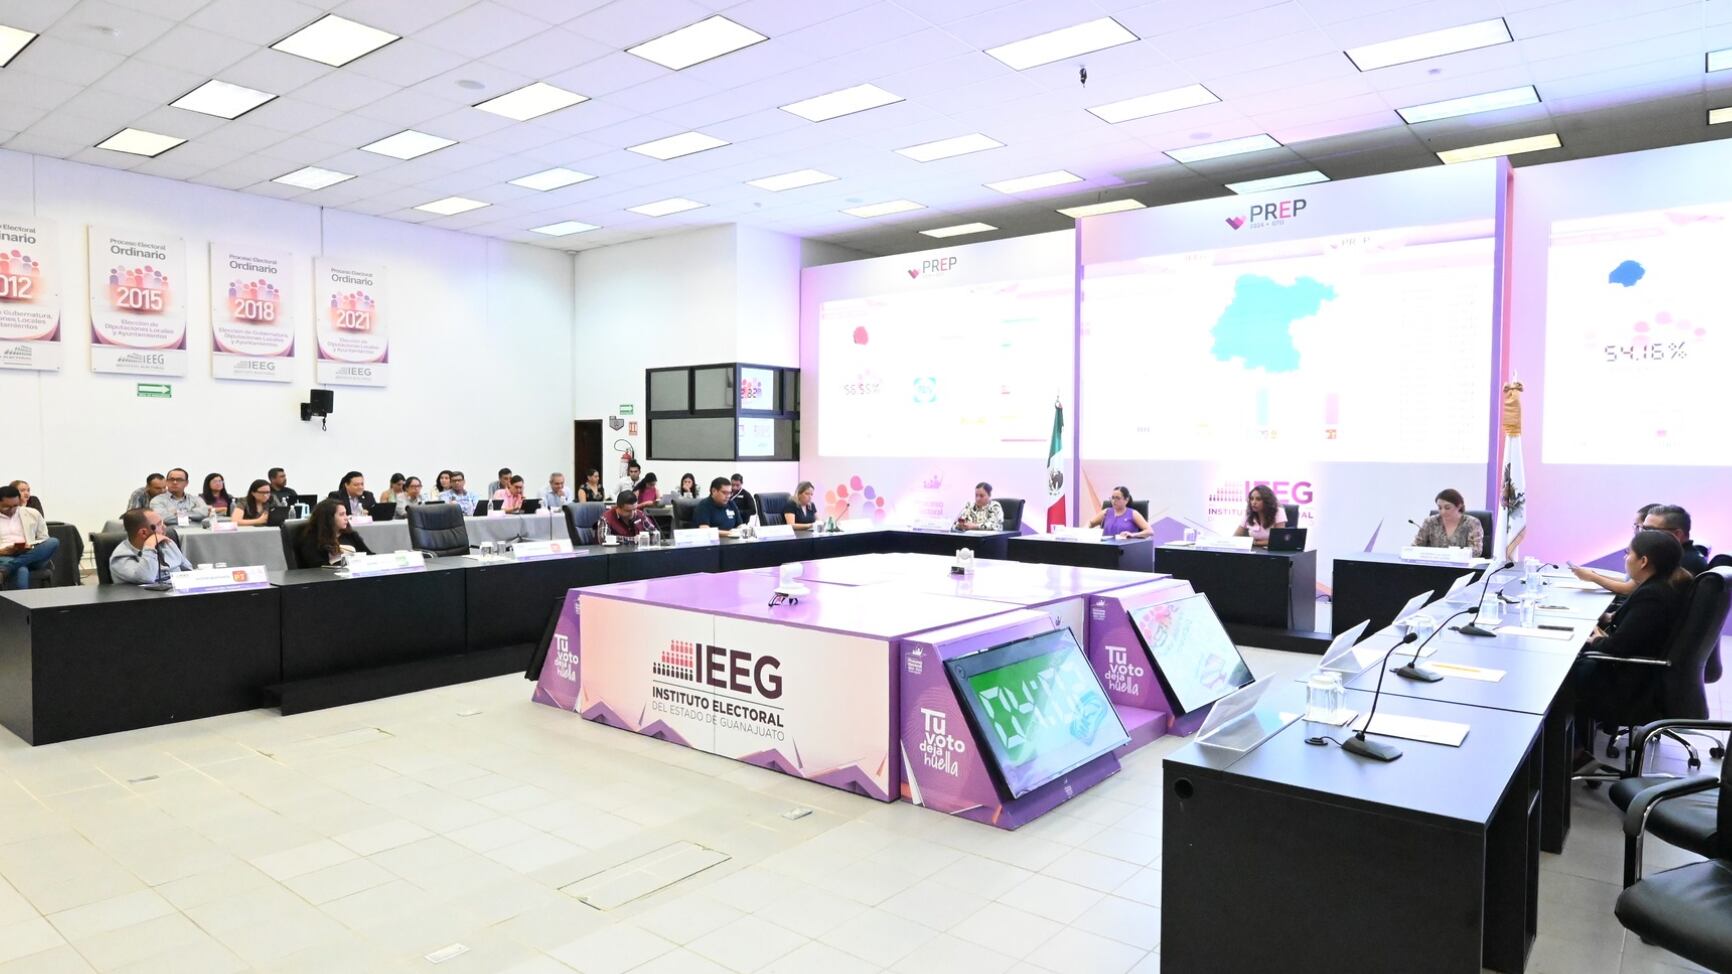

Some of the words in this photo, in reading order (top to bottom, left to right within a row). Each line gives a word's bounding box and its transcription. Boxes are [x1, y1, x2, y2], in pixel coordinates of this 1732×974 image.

[1250, 199, 1307, 223] PREP
[110, 245, 166, 260] Ordinario
[229, 260, 278, 274] Ordinario
[922, 256, 957, 273] PREP
[331, 274, 373, 286] Ordinario
[117, 286, 162, 310] 2015
[234, 299, 275, 320] 2018
[336, 309, 370, 329] 2021
[143, 354, 164, 365] IEEG
[248, 361, 276, 370] IEEG
[348, 368, 372, 376] IEEG
[554, 633, 569, 652] Tu
[557, 651, 579, 664] voto
[1105, 645, 1127, 665] Tu
[696, 643, 783, 700] IEEG
[1104, 670, 1125, 683] deja
[1109, 664, 1144, 677] voto
[1109, 676, 1139, 696] huella
[652, 686, 709, 710] INSTITUTO
[712, 700, 784, 728] ELECTORAL
[652, 701, 668, 713] DEL
[670, 705, 704, 722] ESTADO
[705, 713, 718, 725] DE
[719, 717, 785, 741] GUANAJUATO
[920, 707, 946, 736] Tu
[919, 739, 943, 757] deja
[925, 731, 966, 753] voto
[924, 749, 958, 777] huella
